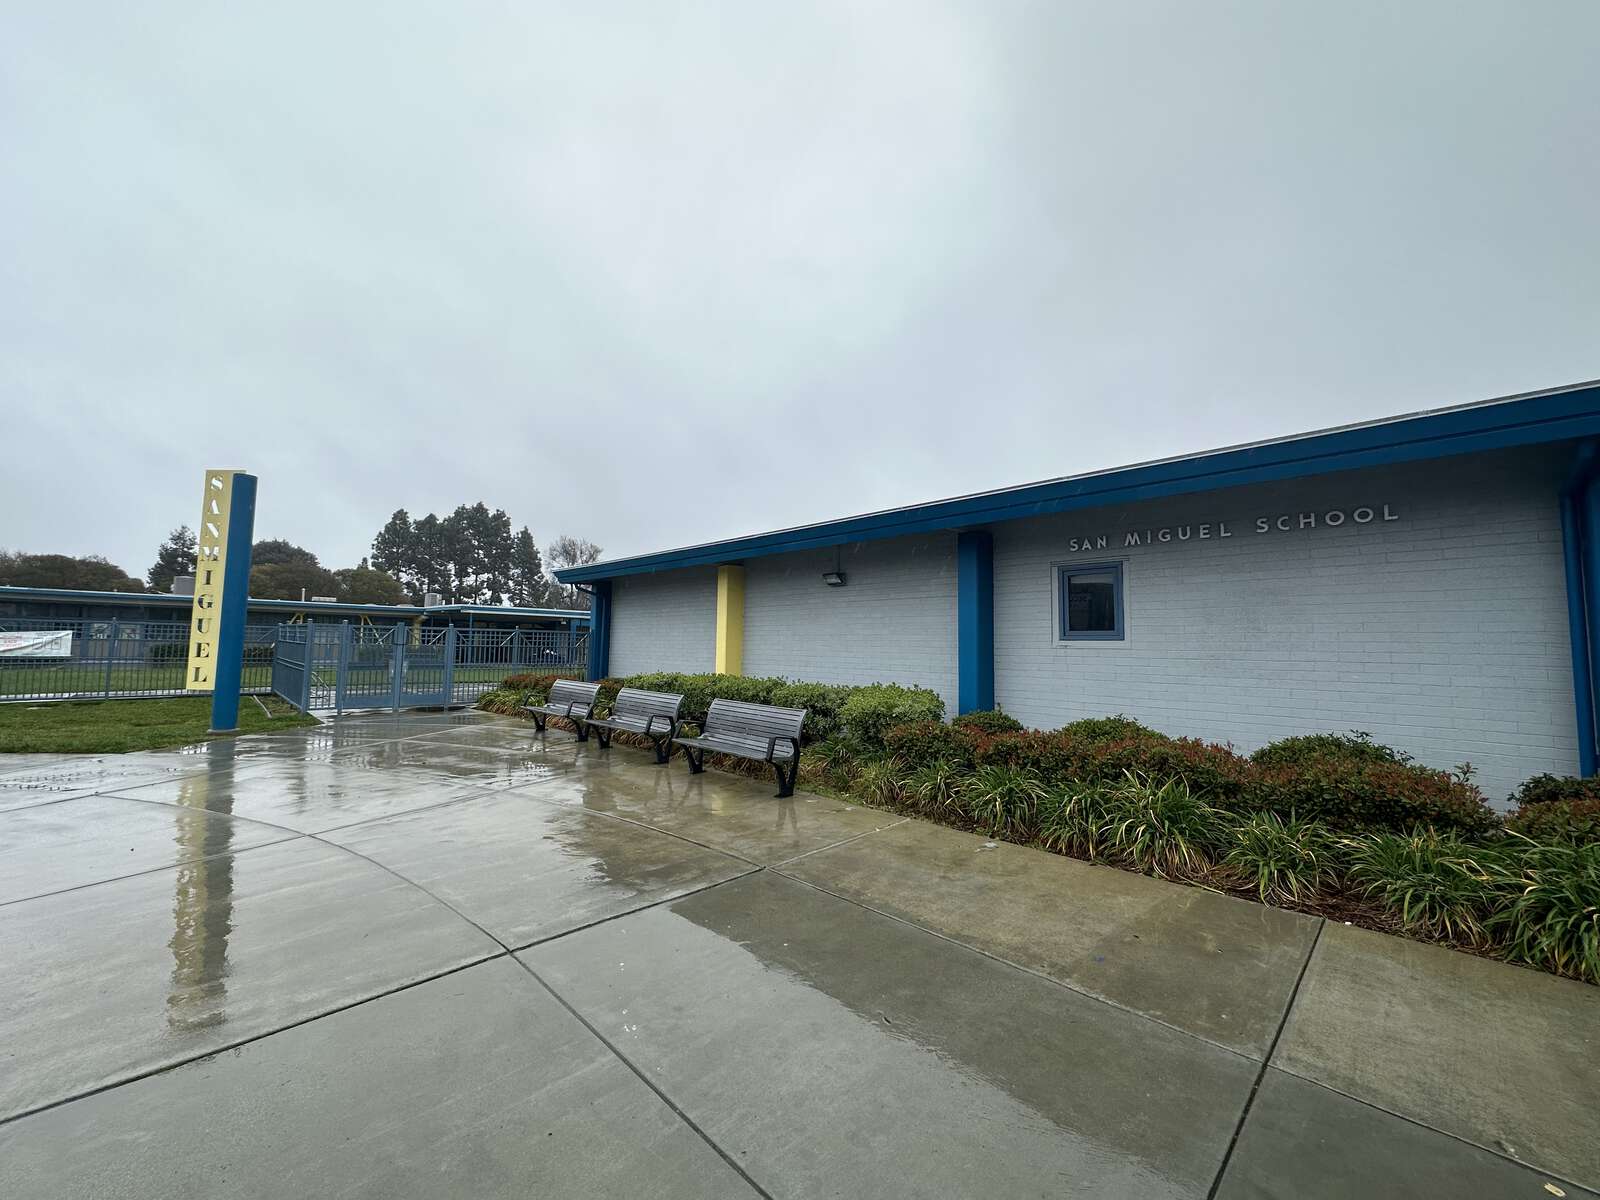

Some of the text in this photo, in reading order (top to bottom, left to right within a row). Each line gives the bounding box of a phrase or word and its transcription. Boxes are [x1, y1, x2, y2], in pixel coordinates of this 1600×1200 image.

[1069, 504, 1399, 552] SAN MIGUEL SCHOOL
